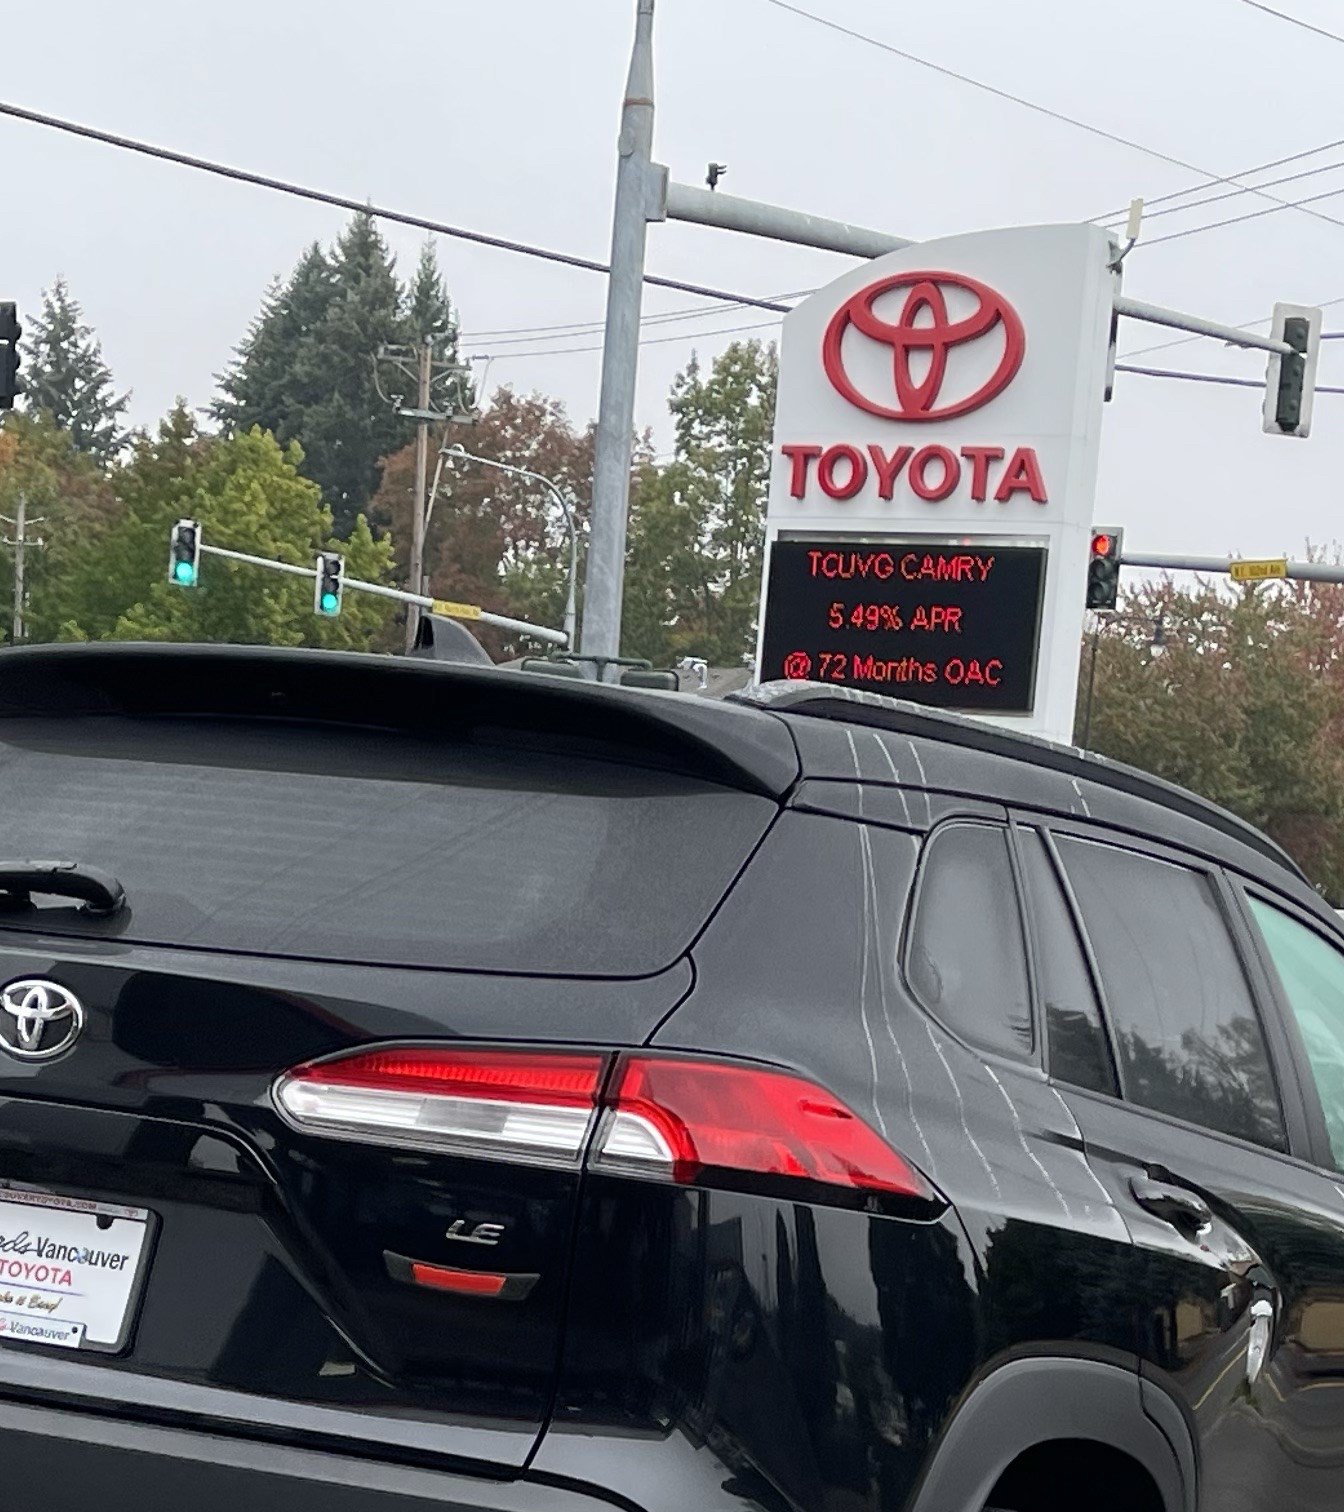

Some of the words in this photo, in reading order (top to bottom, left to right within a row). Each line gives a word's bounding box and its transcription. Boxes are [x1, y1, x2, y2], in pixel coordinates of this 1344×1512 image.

[781, 443, 1049, 504] TOYOTA
[899, 553, 996, 582] CAMRY
[909, 604, 964, 634] APR
[783, 651, 813, 680] @
[818, 652, 848, 680] 72
[853, 653, 939, 684] Months
[943, 656, 1004, 687] OAC
[445, 1219, 505, 1246] LE
[35, 1236, 130, 1272] Vancouver
[9, 1320, 71, 1341] Vancouver
